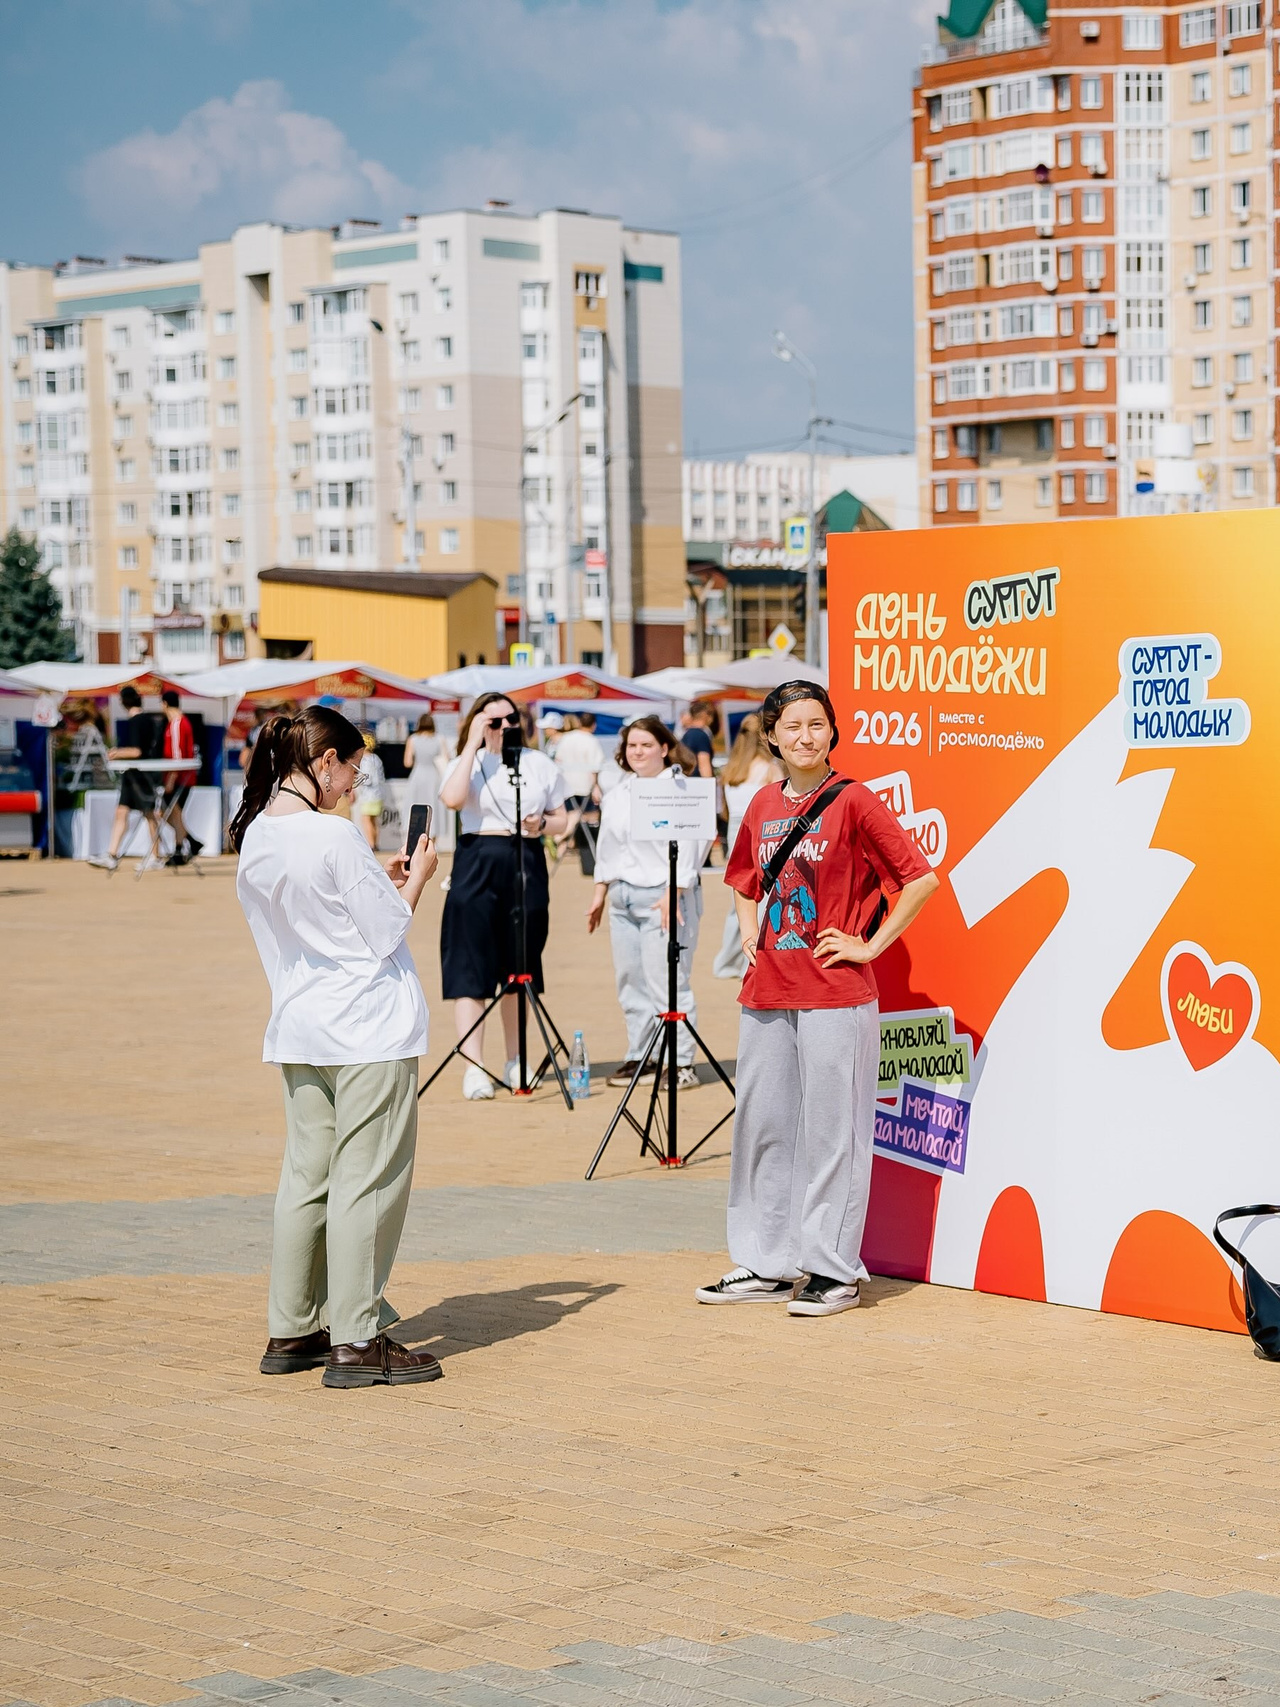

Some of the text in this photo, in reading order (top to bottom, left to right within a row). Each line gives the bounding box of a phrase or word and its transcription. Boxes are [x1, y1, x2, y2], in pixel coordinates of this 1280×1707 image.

[968, 573, 1057, 624] СУРГУТ
[854, 592, 947, 640] ДЕНЬ
[853, 635, 1047, 695] МОЛОДЁЖИ
[1132, 644, 1202, 675] СУРГУТ
[1133, 678, 1191, 707] ГОРОД
[853, 709, 922, 746] 2026
[938, 713, 985, 725] вместе с
[1133, 708, 1232, 739] МОЛОДЫХ
[938, 731, 1045, 752] росмолодёжь
[875, 783, 906, 817] РИ
[764, 822, 780, 835] WEB
[1177, 991, 1233, 1034] ЛЮБИ
[880, 1019, 946, 1050] ХНОВЛЯЙ,
[900, 1048, 963, 1078] МОЛОДОЙ
[895, 1124, 963, 1166] МОЛОДОЙ
